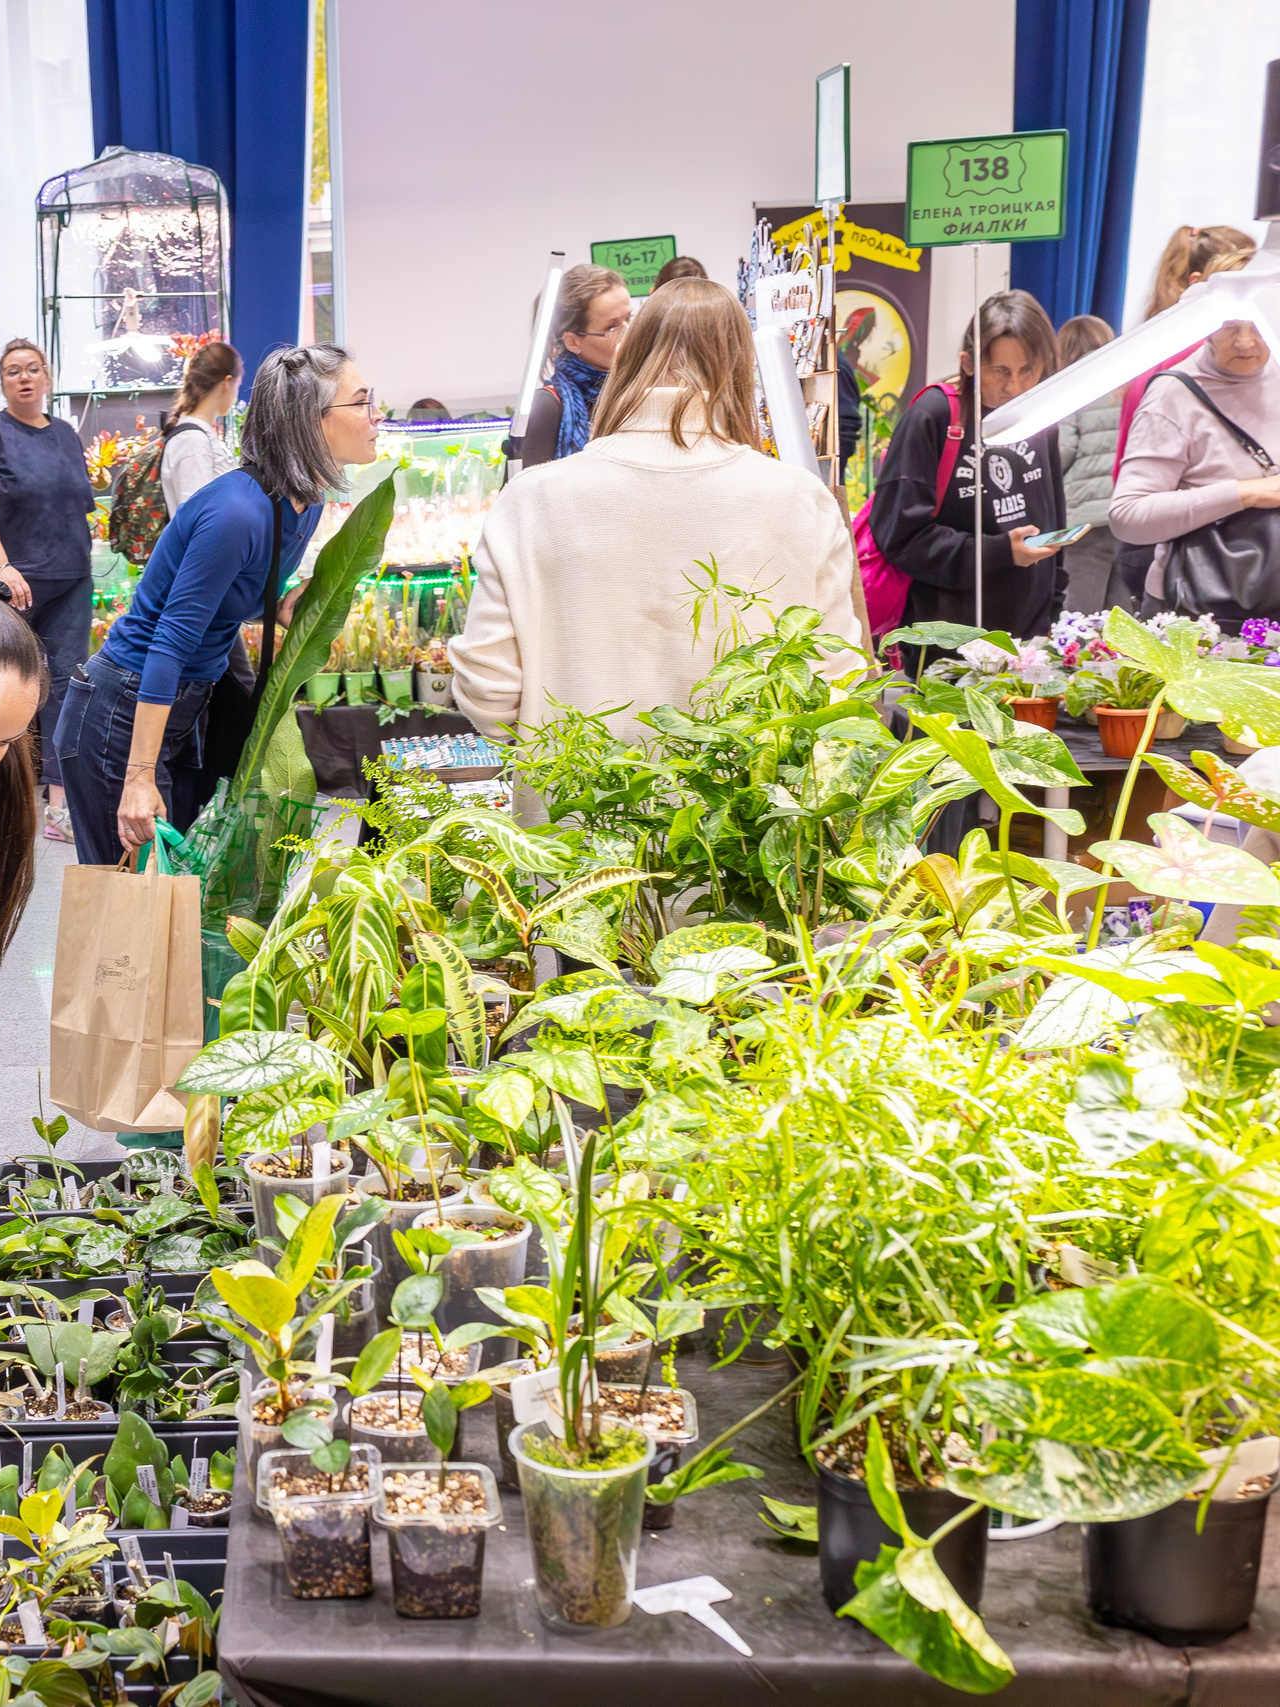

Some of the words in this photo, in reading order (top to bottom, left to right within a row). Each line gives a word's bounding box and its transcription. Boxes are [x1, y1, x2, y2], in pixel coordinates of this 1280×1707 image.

[959, 155, 1010, 183] 138
[913, 206, 963, 221] ЕЛЕНА
[969, 200, 1056, 217] ТРОИЦКАЯ
[943, 218, 1028, 236] ФИАЛКИ
[851, 230, 912, 260] ПРОДАЖА
[614, 250, 657, 267] 16-17
[1022, 467, 1042, 484] 1917
[992, 493, 1027, 517] PARIS
